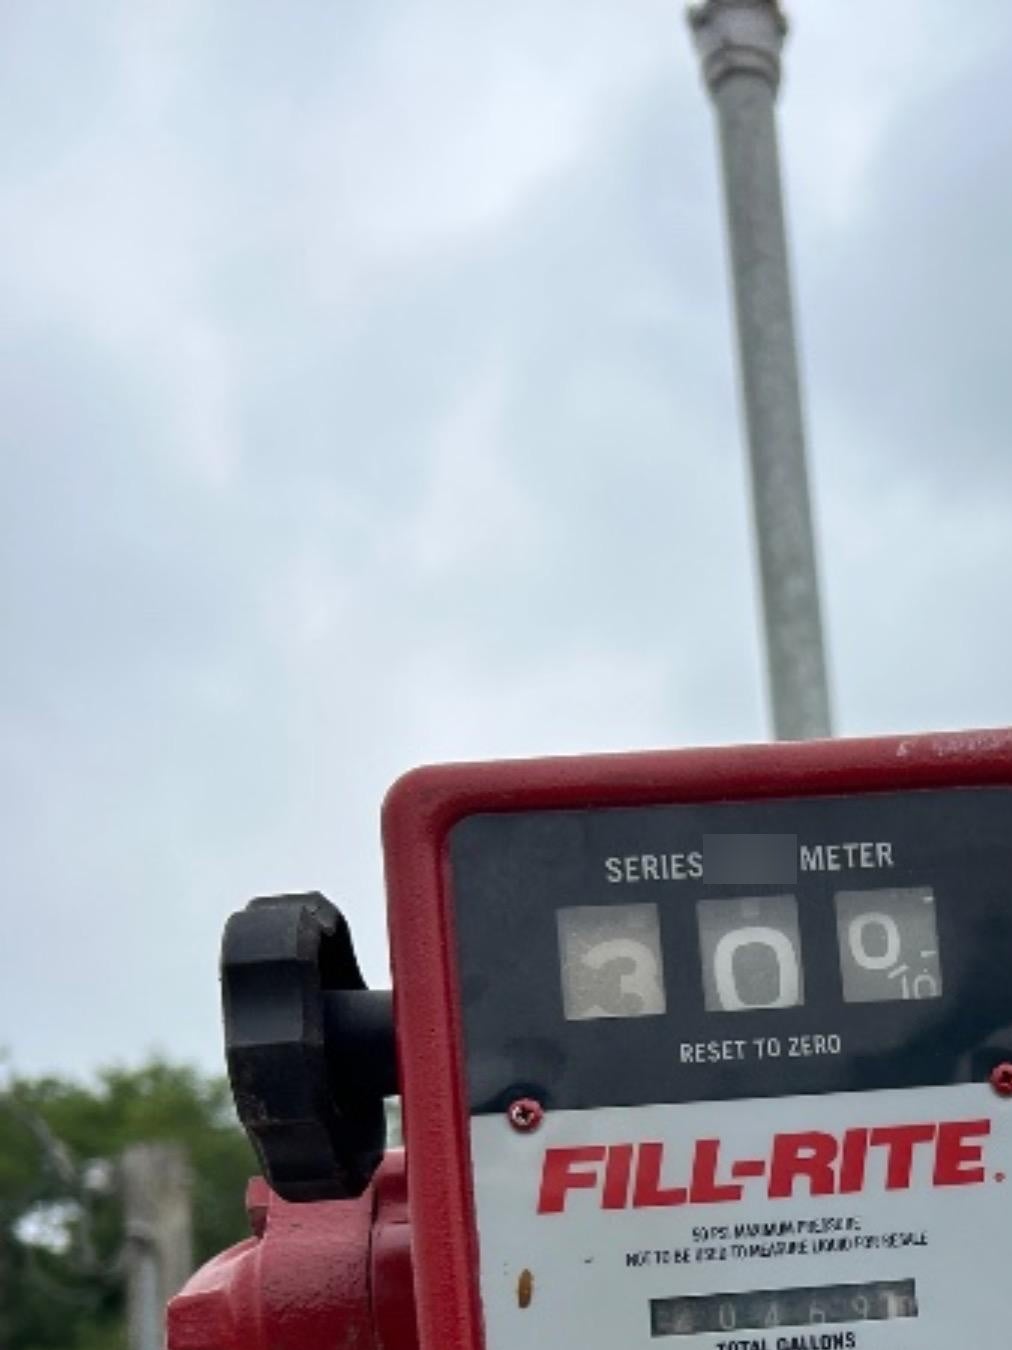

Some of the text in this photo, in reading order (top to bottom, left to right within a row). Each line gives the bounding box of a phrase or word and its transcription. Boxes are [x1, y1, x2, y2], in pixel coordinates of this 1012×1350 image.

[605, 842, 894, 883] SERIES METER
[680, 1034, 841, 1063] RESET TO ZERO
[537, 1119, 990, 1215] FILL-RITE
